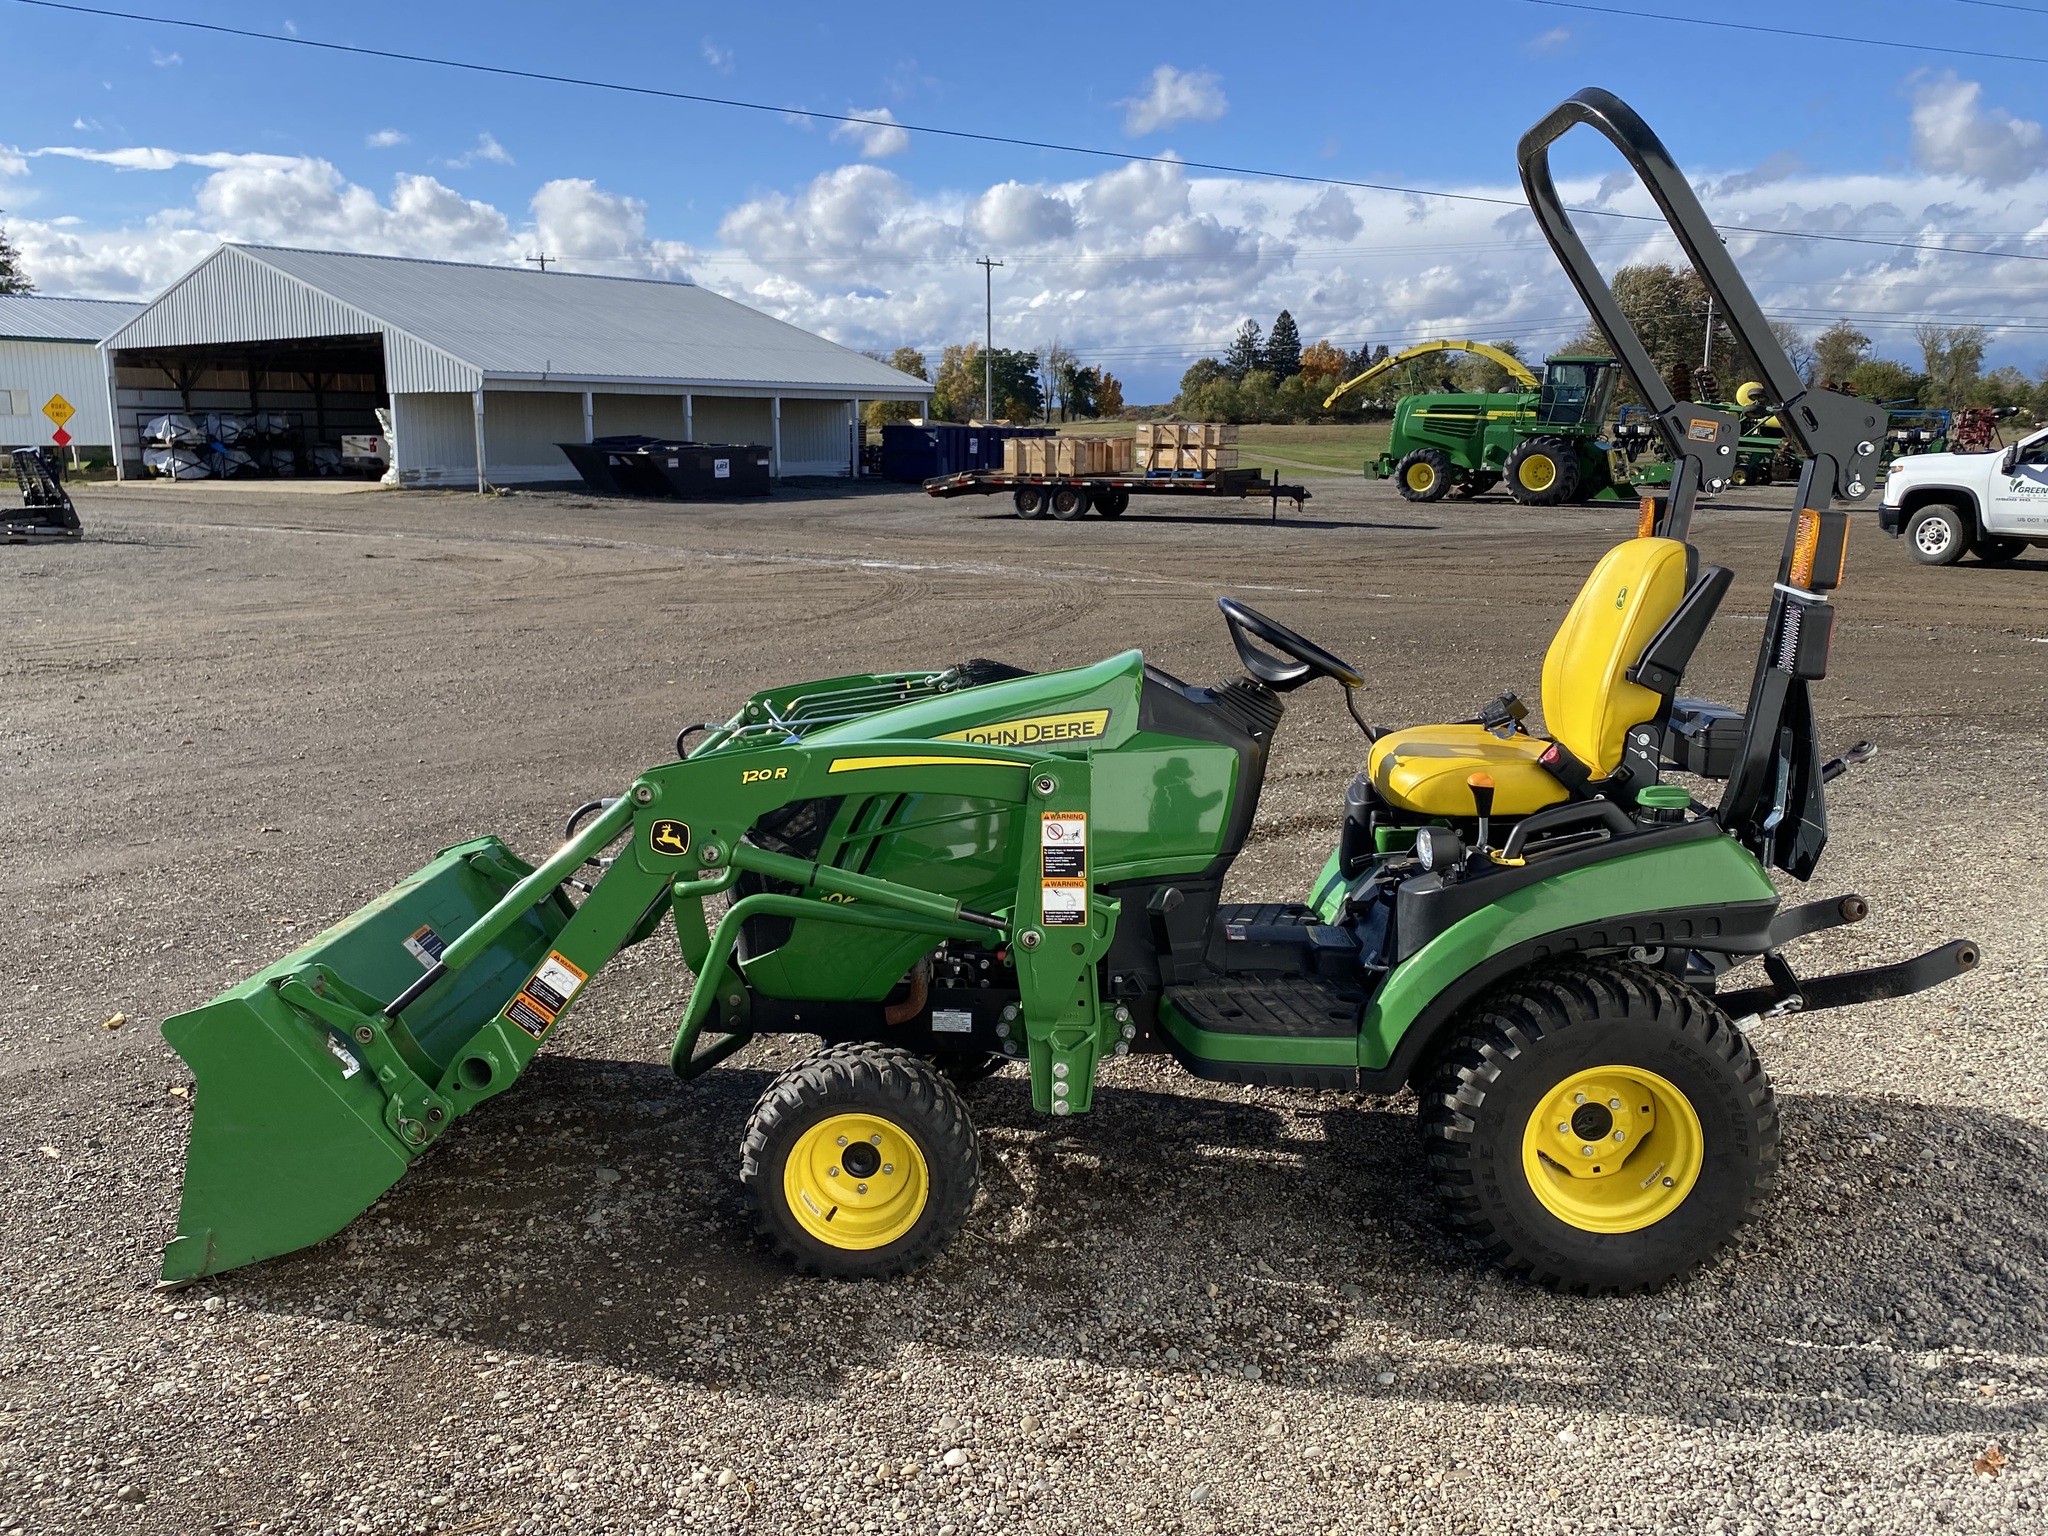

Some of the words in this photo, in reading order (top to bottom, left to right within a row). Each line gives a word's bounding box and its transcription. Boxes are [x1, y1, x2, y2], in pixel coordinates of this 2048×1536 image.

[1023, 721, 1095, 742] DEERE
[560, 959, 583, 978] WARNING
[527, 1001, 550, 1020] WARNING
